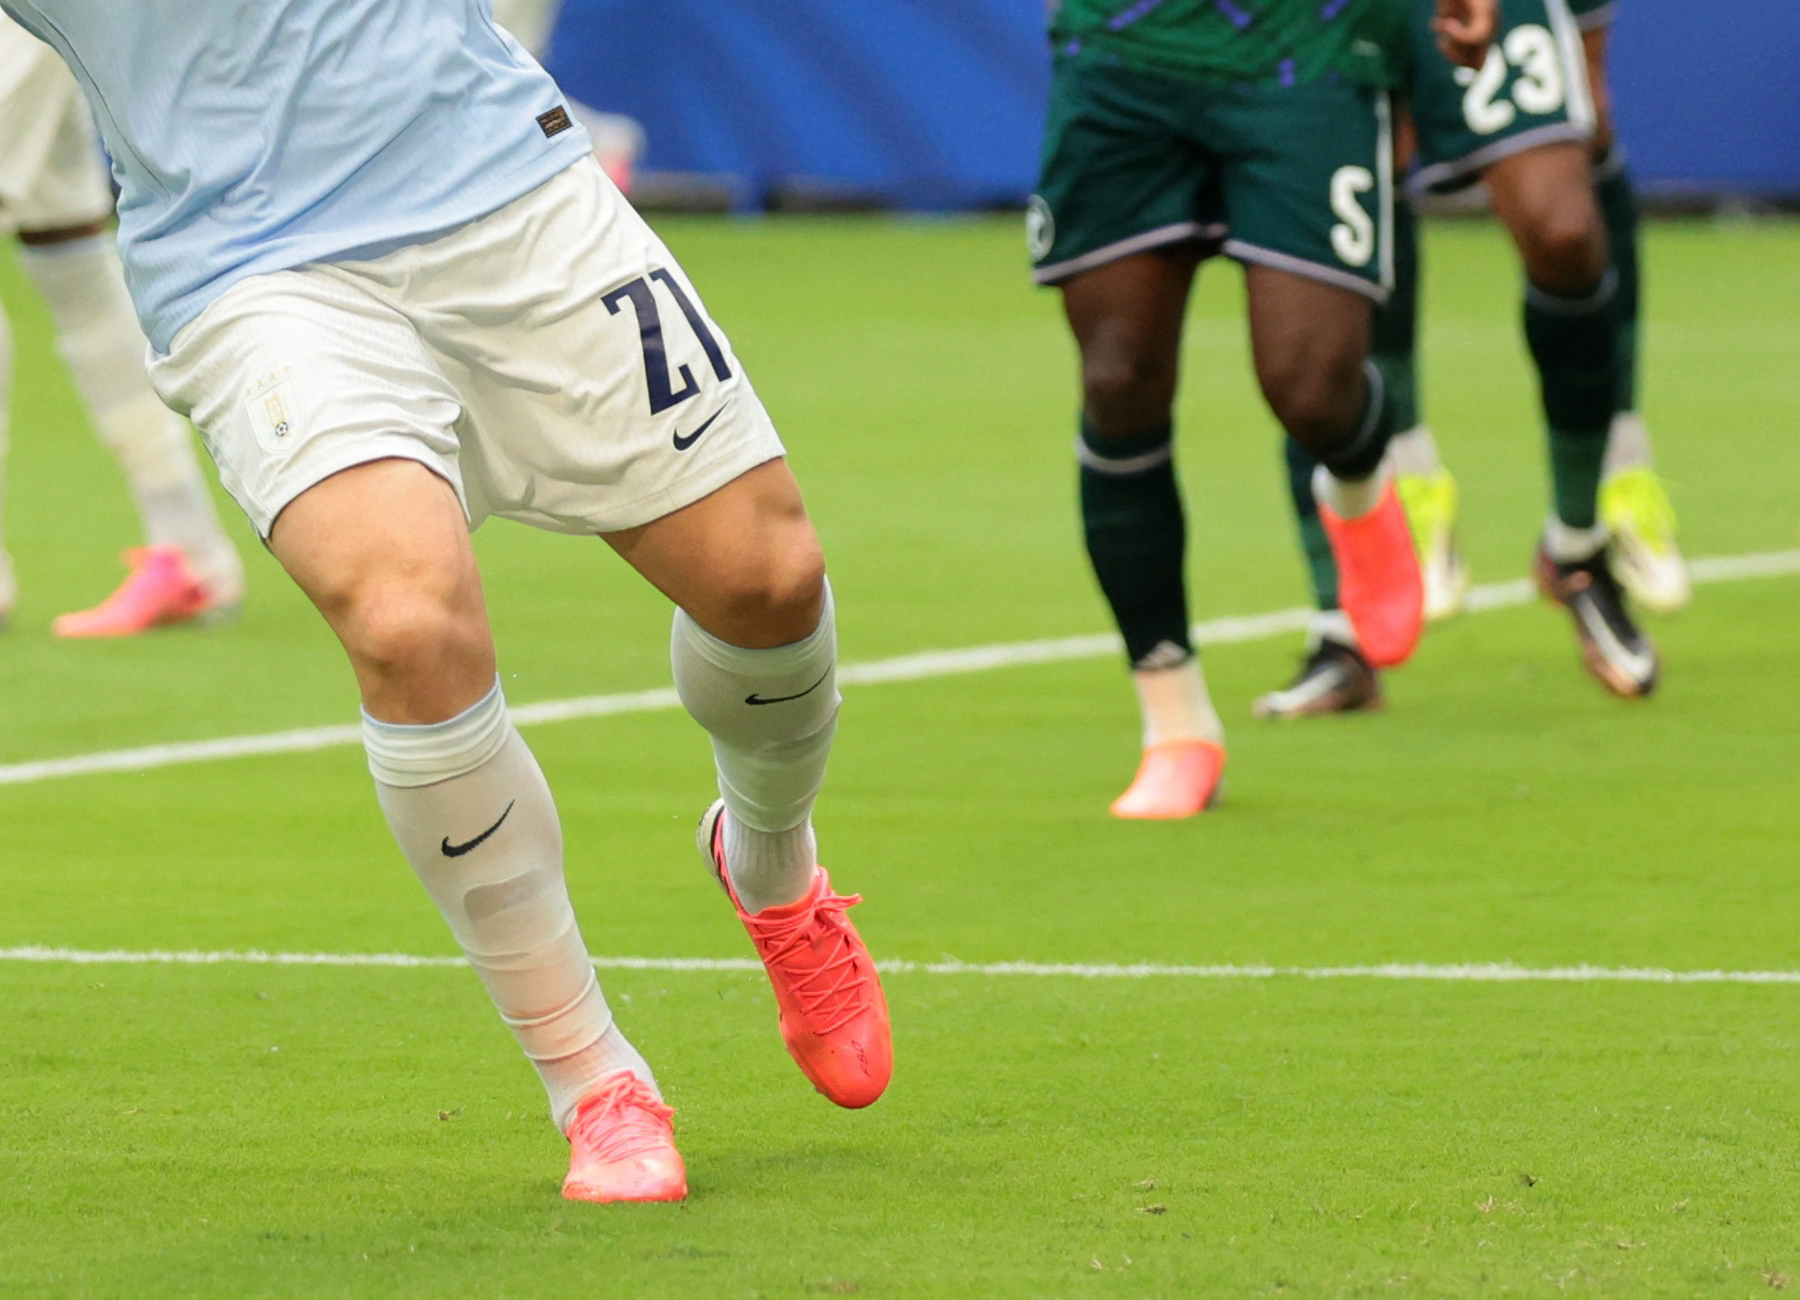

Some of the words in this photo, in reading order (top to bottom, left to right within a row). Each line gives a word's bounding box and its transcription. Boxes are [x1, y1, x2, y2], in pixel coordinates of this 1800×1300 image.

[1454, 23, 1564, 135] 23
[1330, 165, 1374, 268] 5
[600, 267, 732, 416] 21
